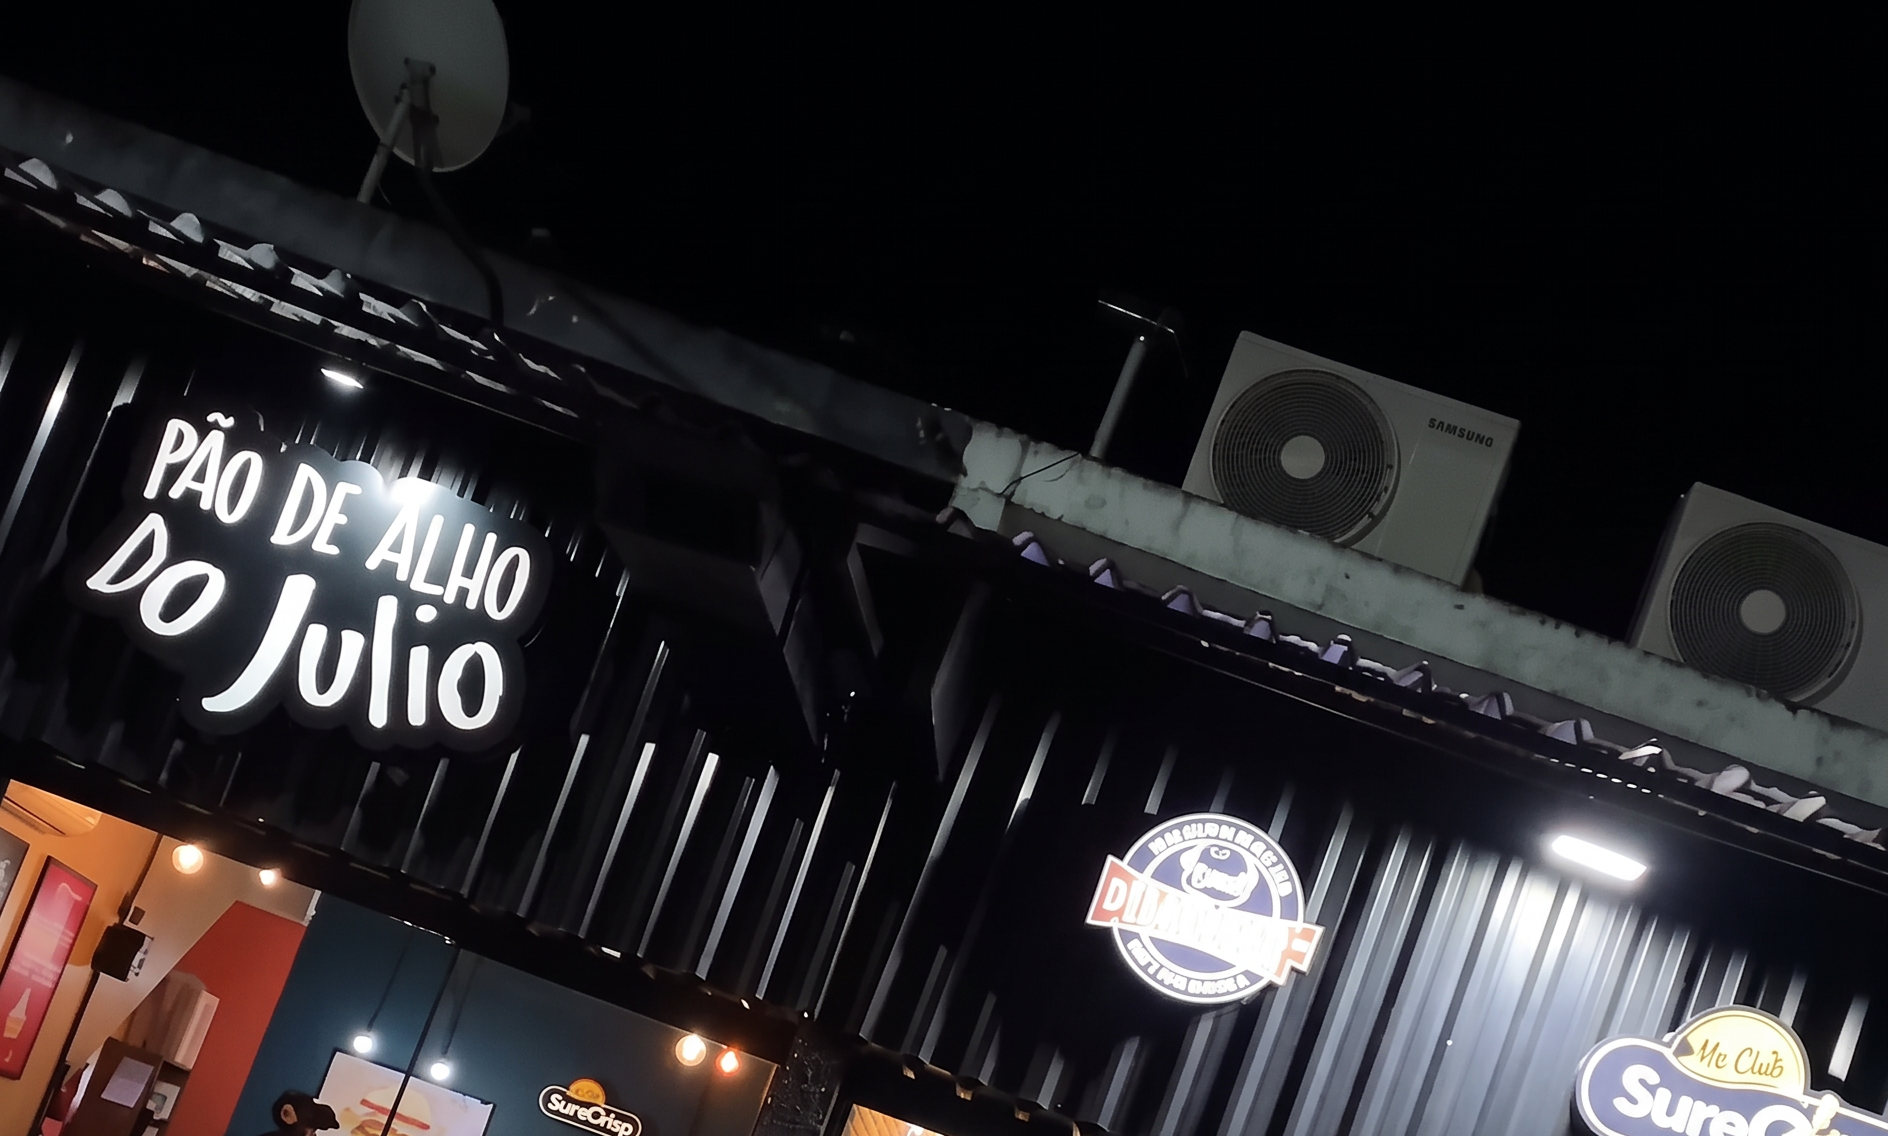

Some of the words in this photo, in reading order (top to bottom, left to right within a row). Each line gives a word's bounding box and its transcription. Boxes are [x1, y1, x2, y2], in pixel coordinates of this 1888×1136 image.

[143, 412, 263, 523] PÃO
[270, 462, 362, 555] DE
[365, 500, 530, 621] ALHO
[1427, 417, 1494, 448] SAMSUNG
[86, 512, 226, 636] DO
[201, 573, 503, 730] Julio
